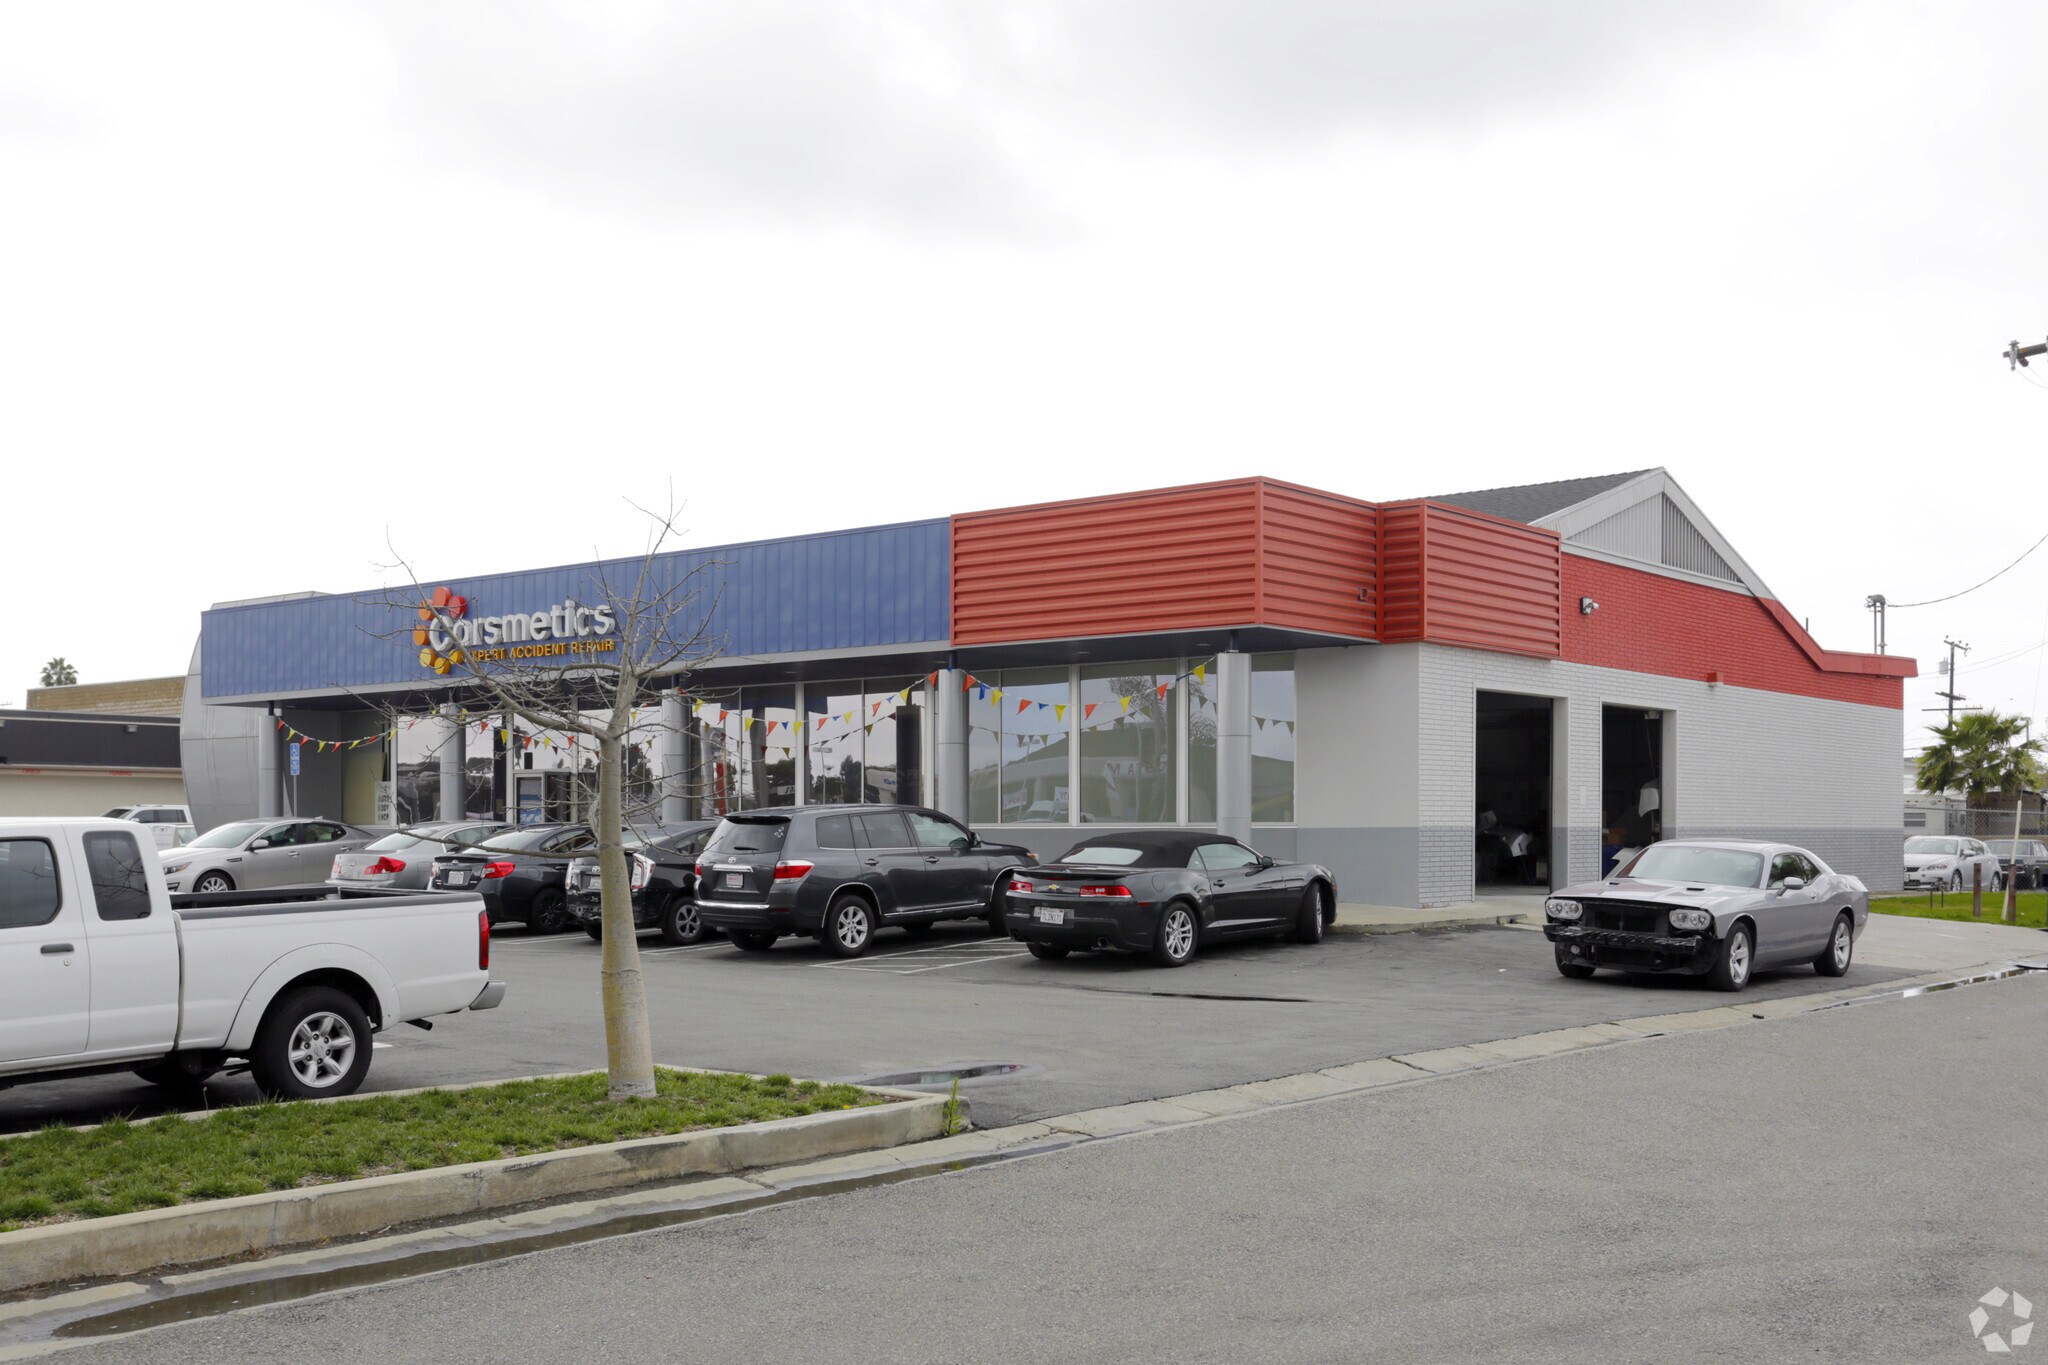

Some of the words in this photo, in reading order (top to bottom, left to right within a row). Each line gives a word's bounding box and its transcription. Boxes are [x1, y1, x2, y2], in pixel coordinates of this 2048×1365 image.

[429, 600, 615, 651] Carsmetics
[467, 647, 507, 661] XPERT
[509, 641, 567, 660] ACCIDENT
